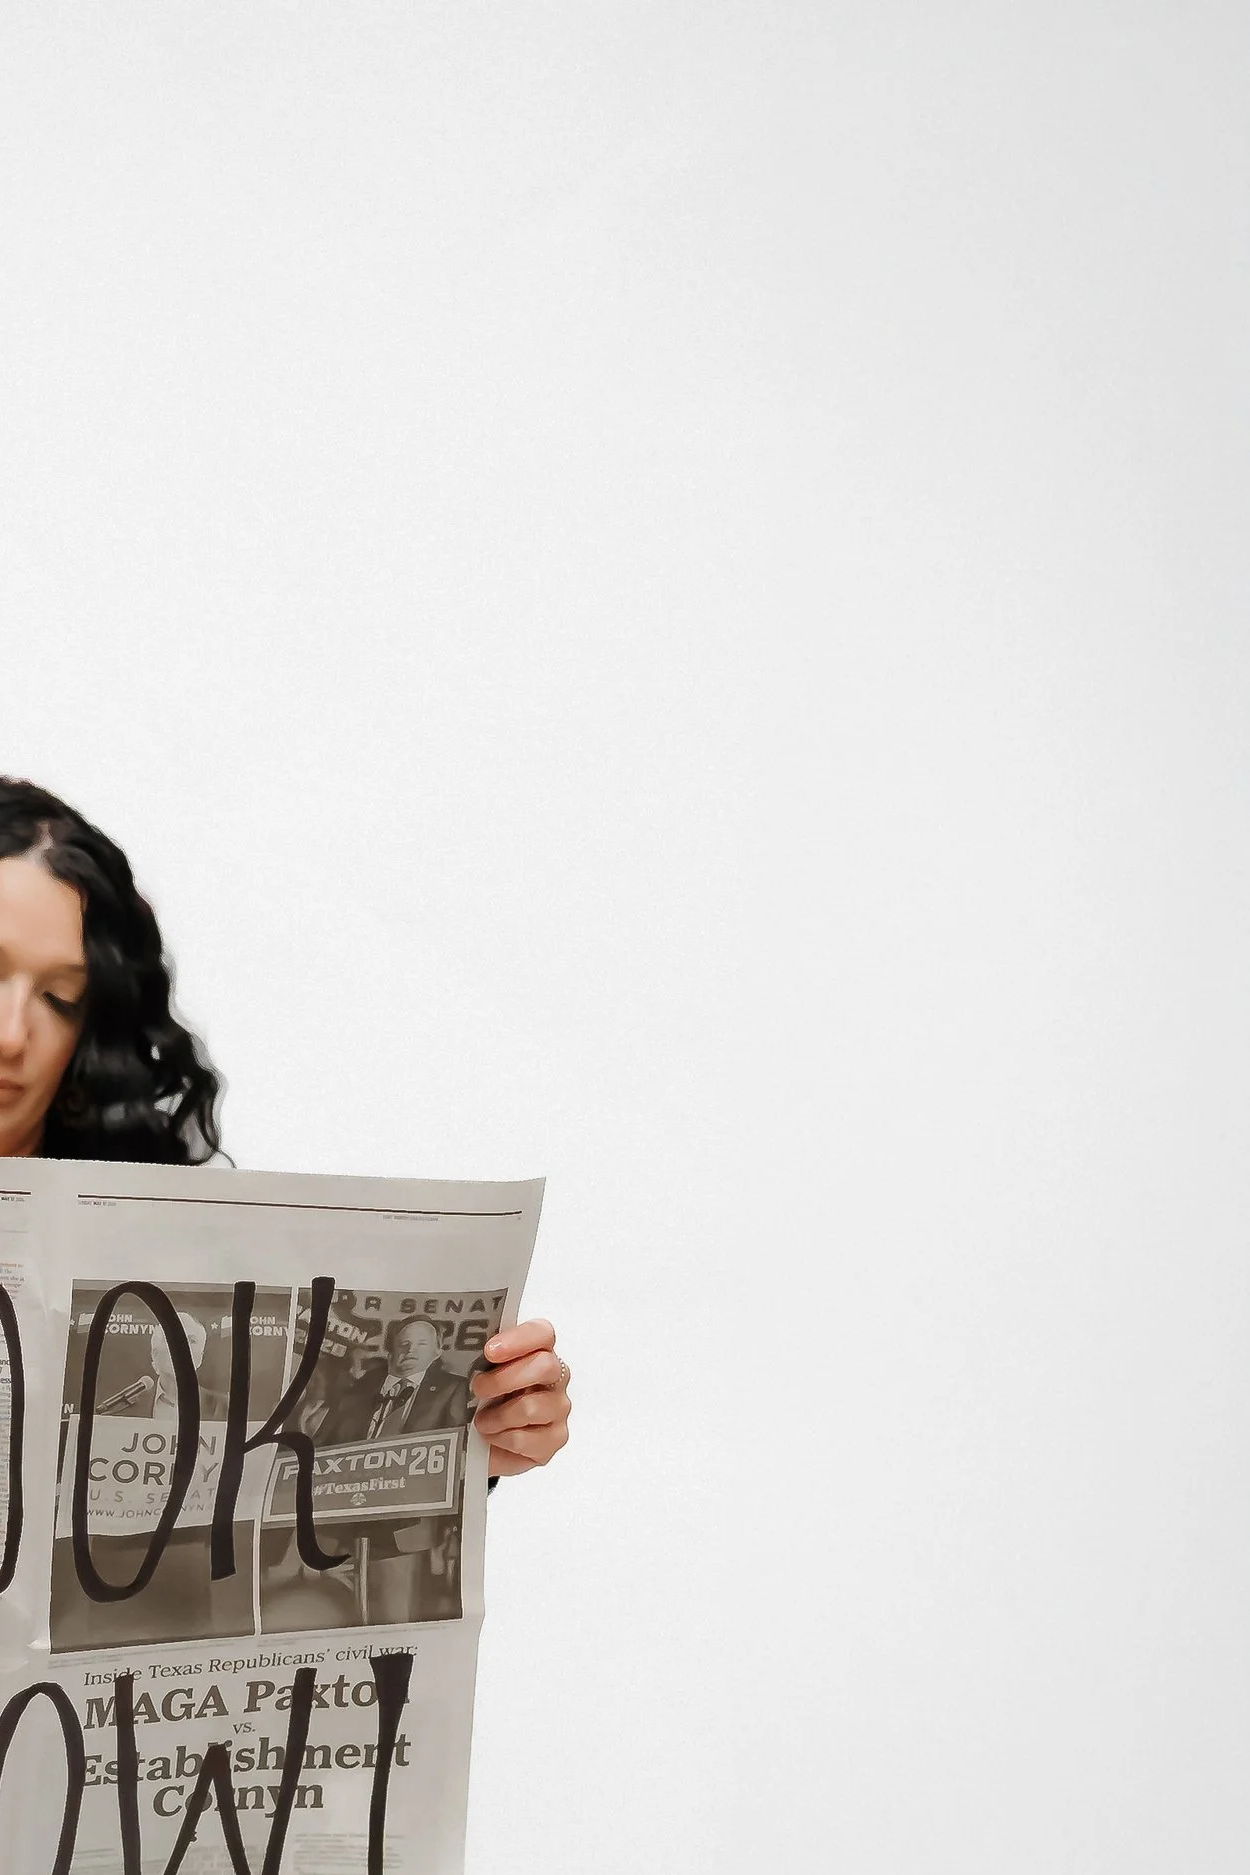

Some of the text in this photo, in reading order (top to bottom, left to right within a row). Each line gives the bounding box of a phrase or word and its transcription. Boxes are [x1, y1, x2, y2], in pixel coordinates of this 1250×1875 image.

[408, 1444, 446, 1476] 26
[312, 1475, 407, 1497] #TexasFirst
[84, 1667, 143, 1686] Inside
[148, 1662, 203, 1680] Texas
[207, 1649, 331, 1673] Republicans'
[335, 1644, 374, 1662] civil
[84, 1673, 410, 1730] MAGA Paxto
[233, 1722, 256, 1735] vs.
